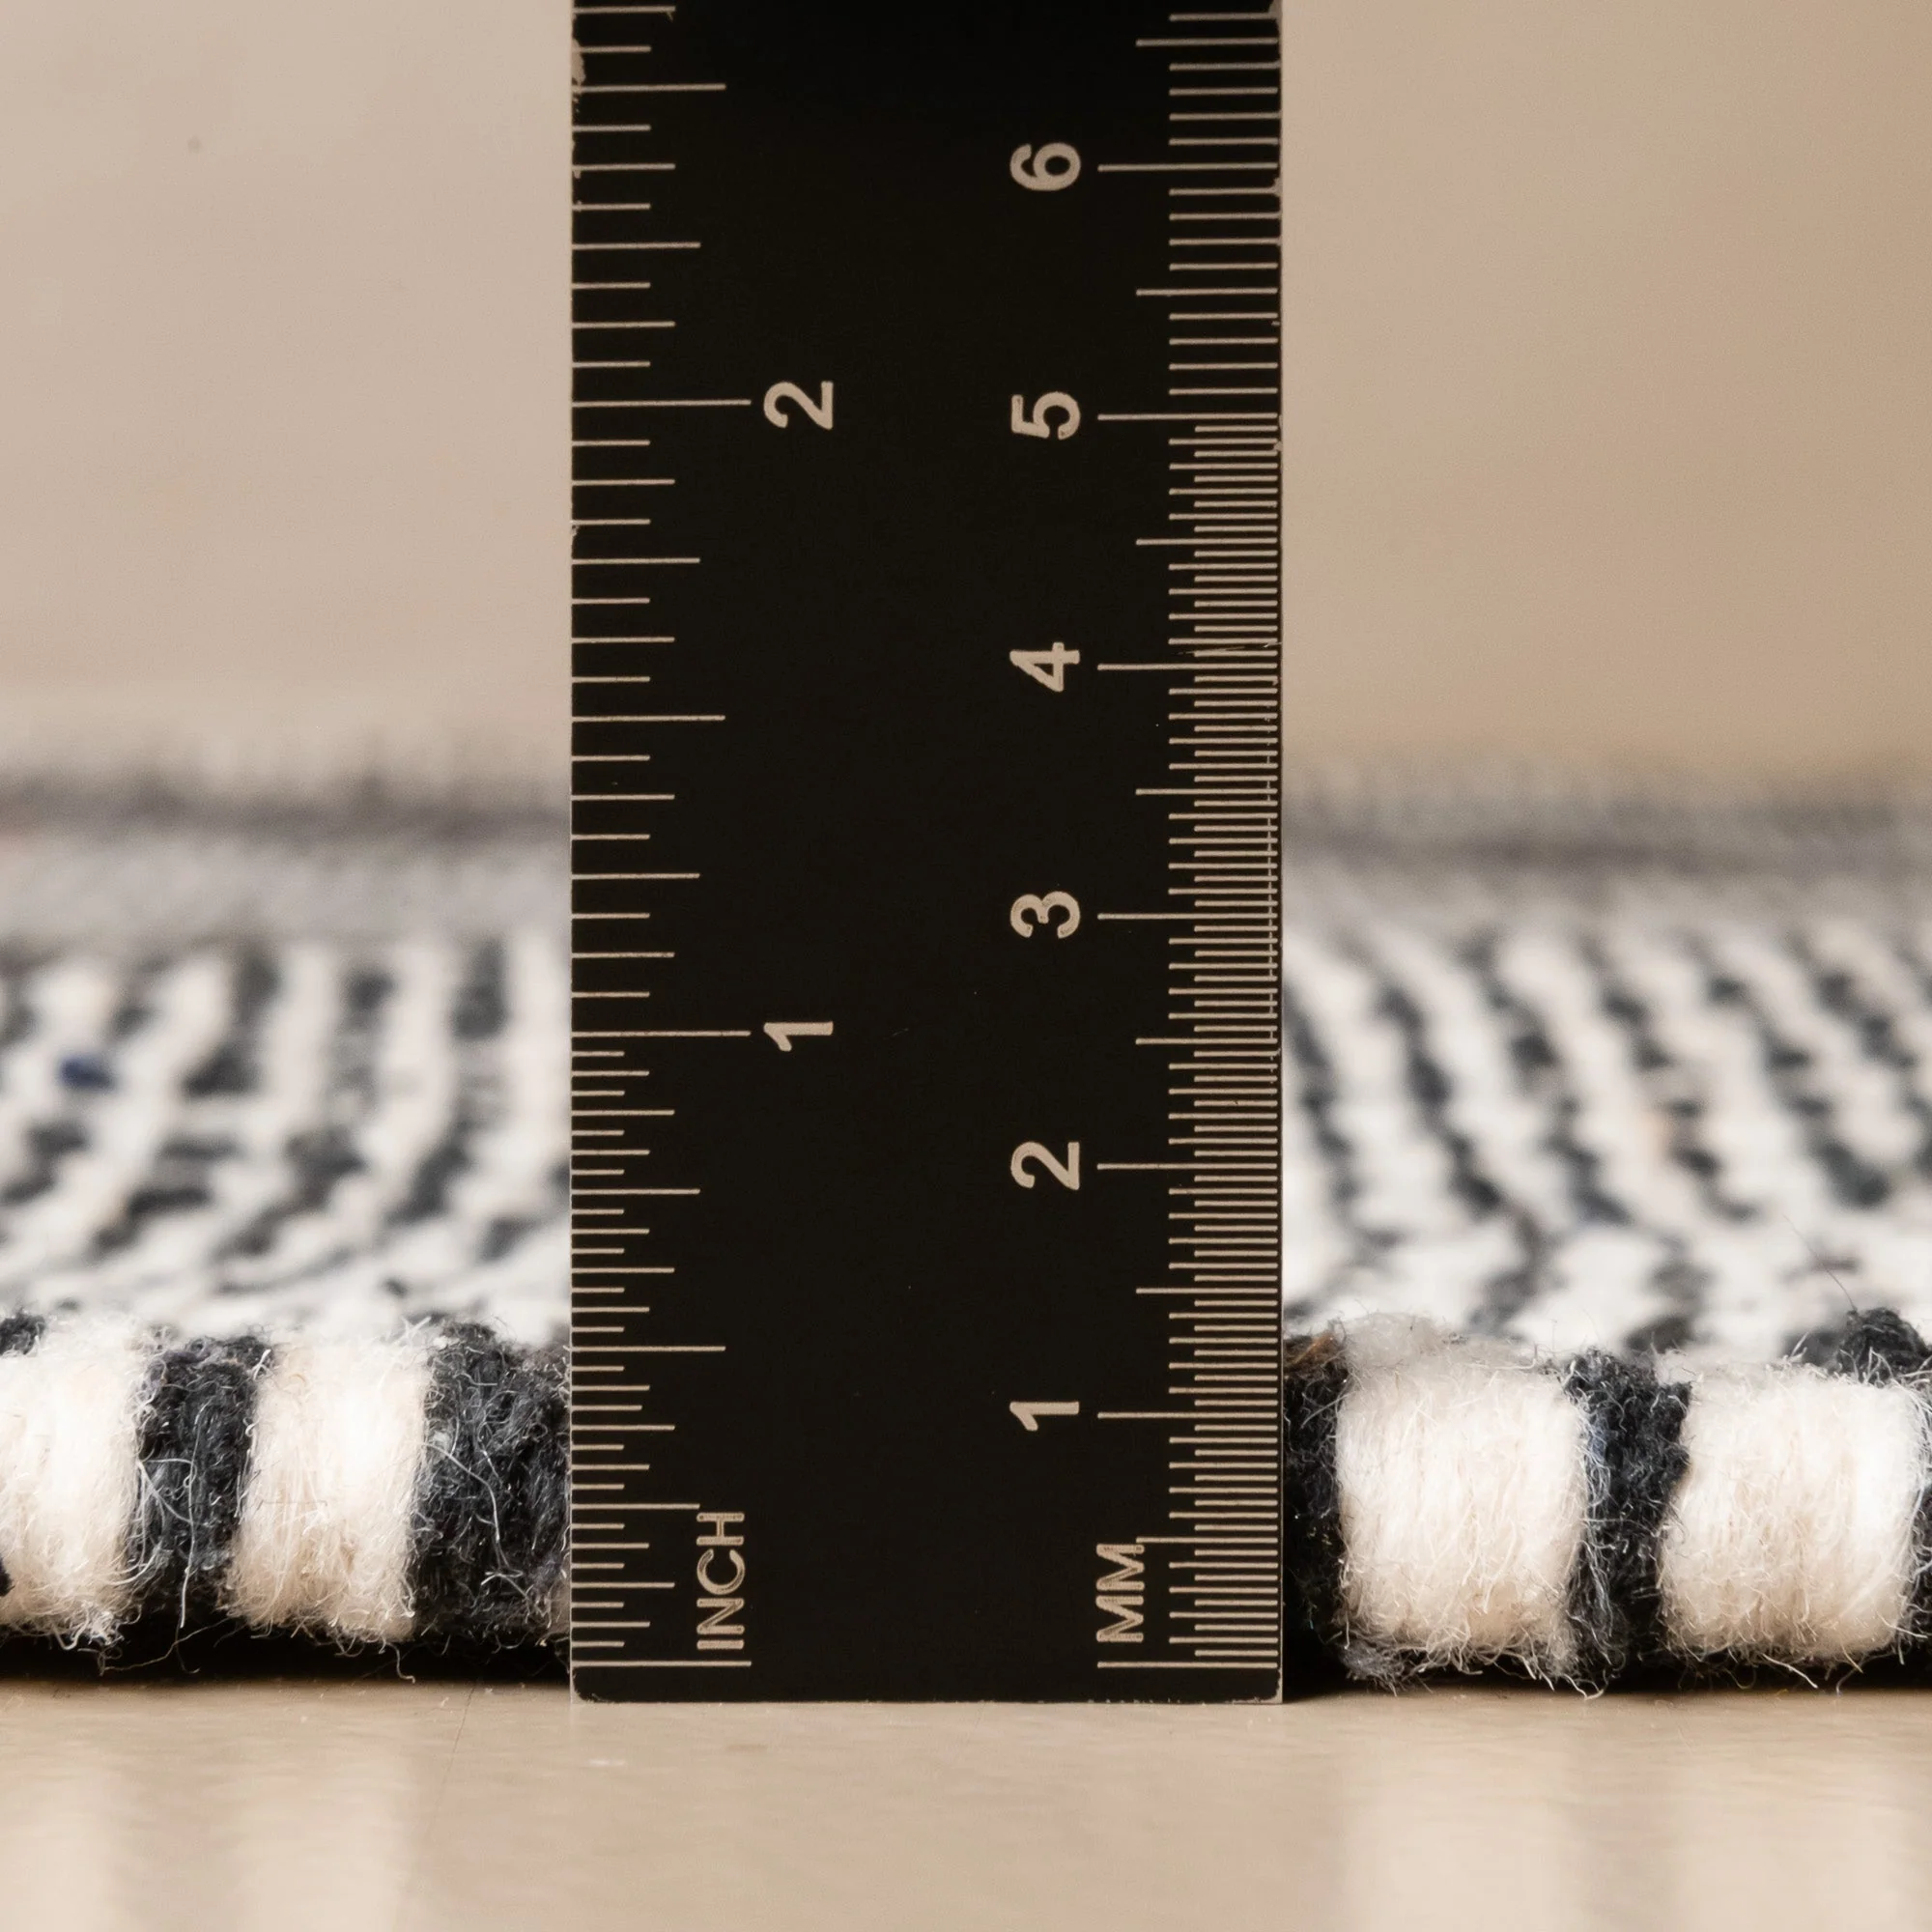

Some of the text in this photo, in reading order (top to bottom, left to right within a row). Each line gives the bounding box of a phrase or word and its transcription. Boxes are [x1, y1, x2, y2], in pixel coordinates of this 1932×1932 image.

[1009, 142, 1082, 191] 6
[762, 381, 835, 431] 2
[1010, 390, 1082, 440] 5
[1009, 641, 1081, 693] 4
[1009, 890, 1081, 939] 3
[762, 1020, 835, 1052] 1
[1009, 1141, 1081, 1191] 2
[1009, 1401, 1080, 1432] 1
[696, 1512, 746, 1651] INCH
[1094, 1543, 1146, 1643] MM
